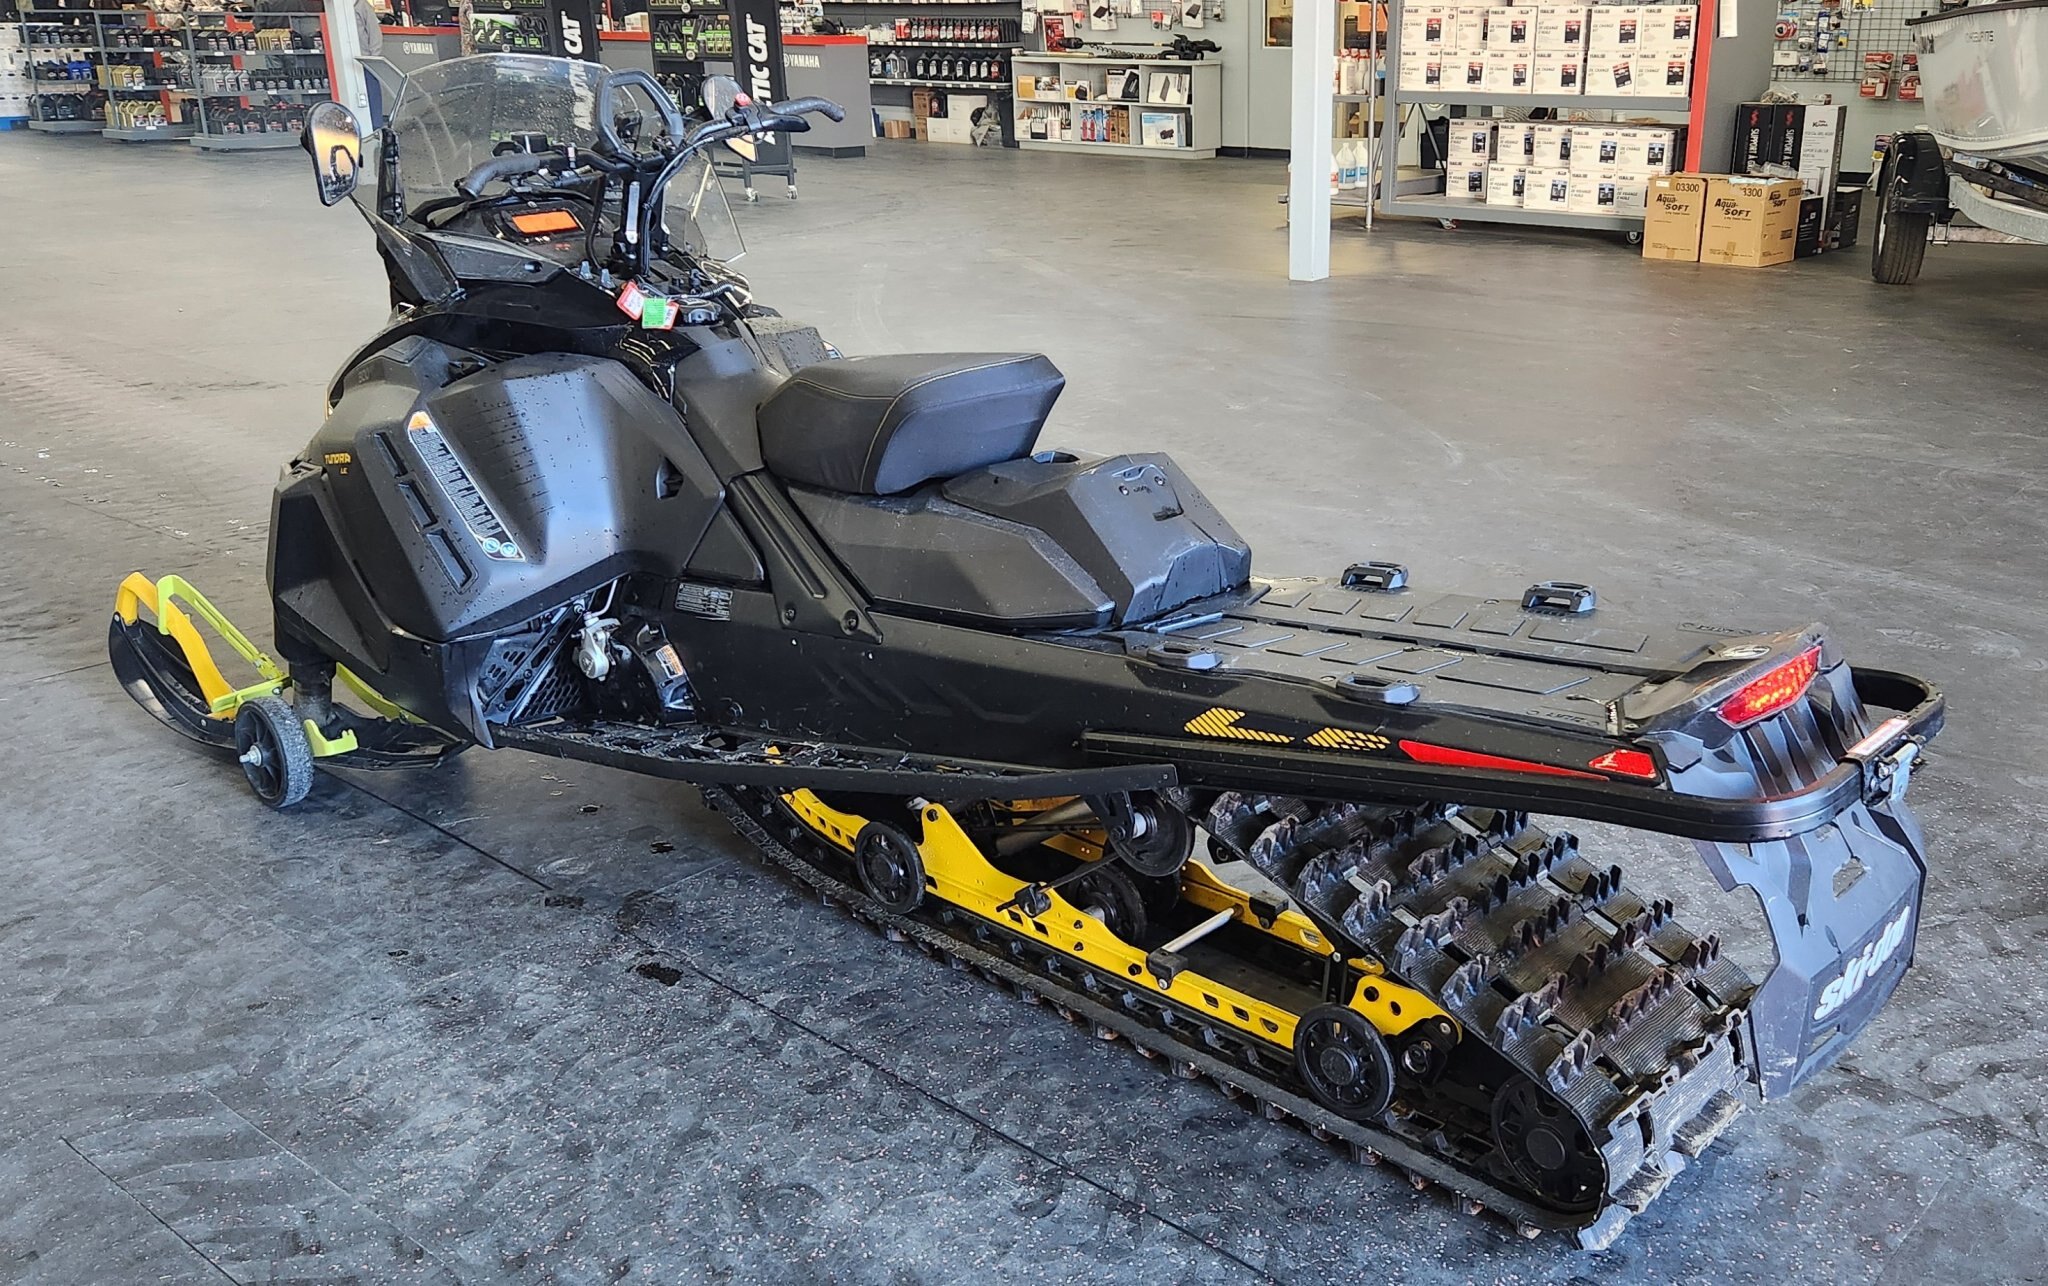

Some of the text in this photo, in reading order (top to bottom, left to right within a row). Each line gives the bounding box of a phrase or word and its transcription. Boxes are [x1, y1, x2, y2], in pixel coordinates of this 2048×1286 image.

[560, 11, 583, 54] CAT
[746, 14, 768, 63] CAT
[409, 42, 434, 54] YAMAHA
[789, 54, 820, 68] YAMAHA
[1748, 128, 1760, 154] SUPPORT
[1784, 129, 1795, 155] SUPPORT
[1676, 182, 1700, 193] 03300
[1656, 193, 1678, 206] Aqua-
[1714, 198, 1739, 211] Aqua-
[1664, 204, 1690, 212] SOFT
[1723, 208, 1752, 217] SOFT
[324, 453, 351, 464] TUNDRA
